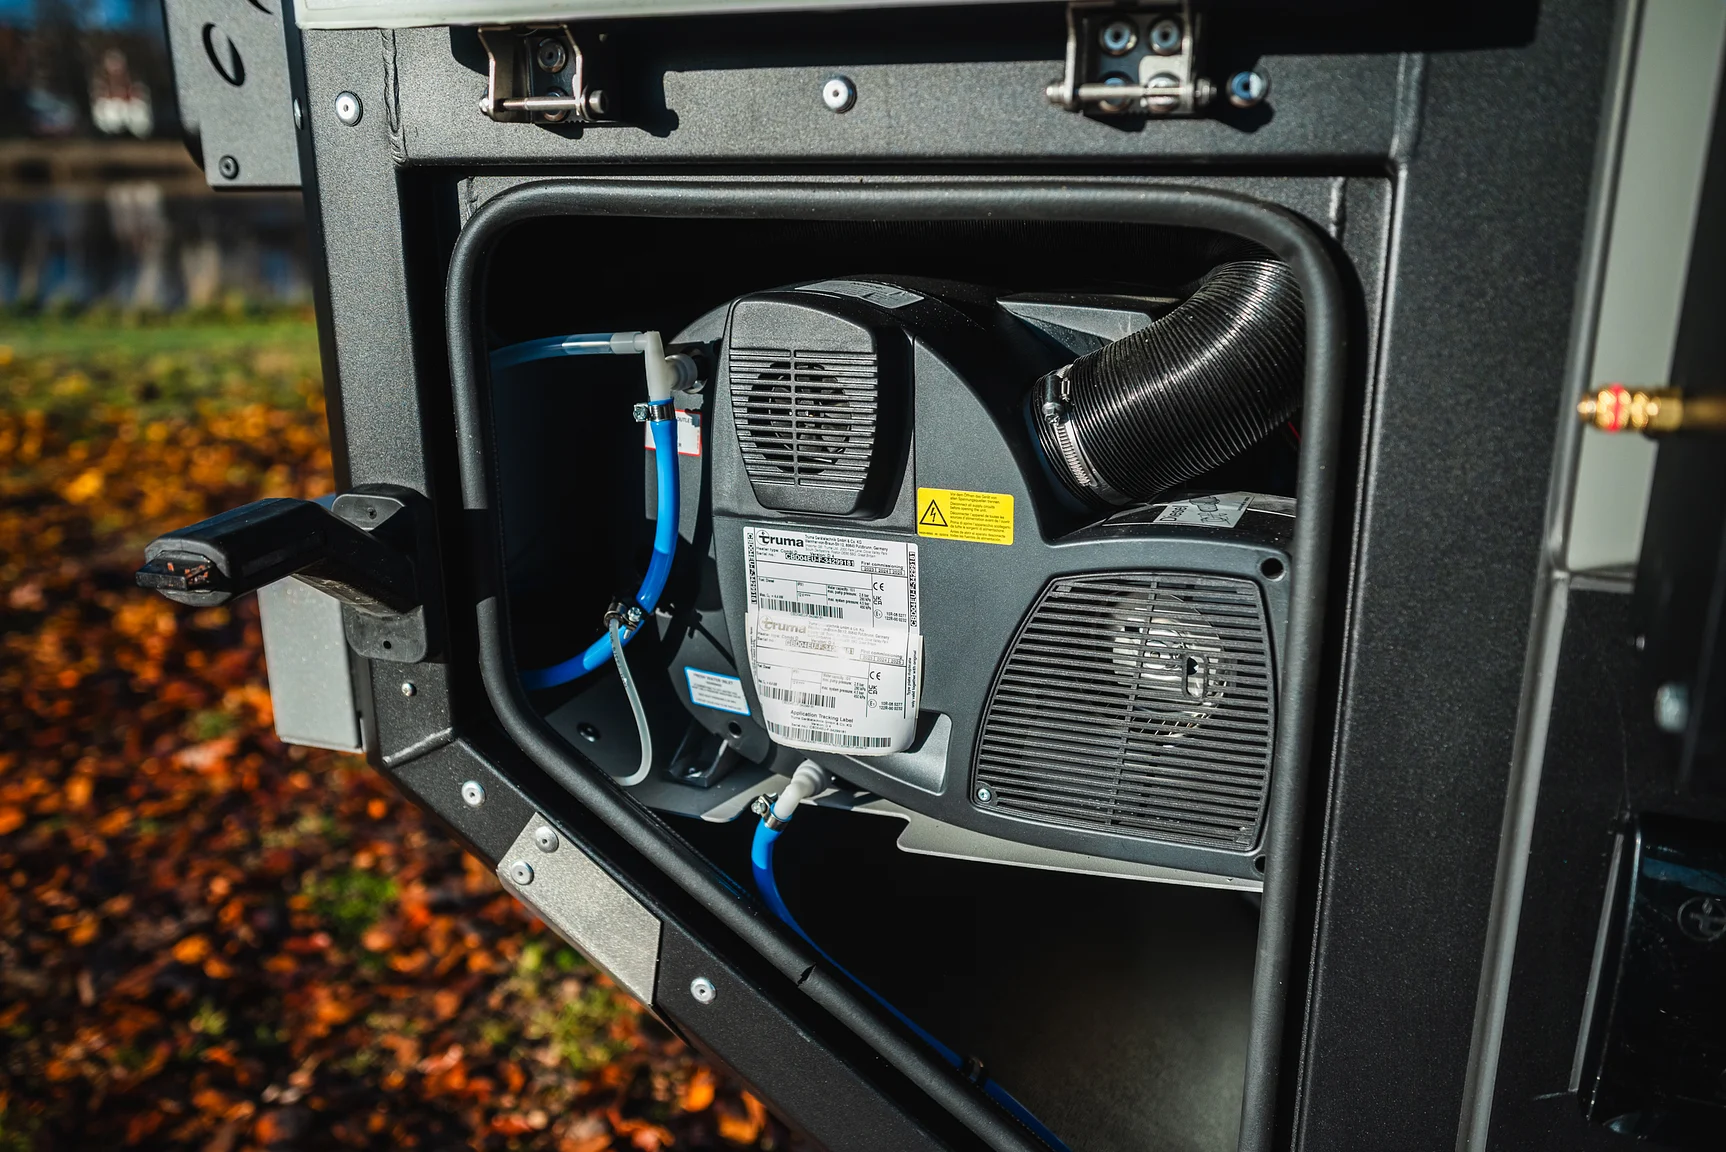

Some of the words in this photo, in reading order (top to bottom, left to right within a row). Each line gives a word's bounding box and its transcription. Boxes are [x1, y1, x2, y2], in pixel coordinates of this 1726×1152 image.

[1160, 505, 1188, 521] Diesel
[758, 532, 804, 547] truma
[872, 562, 904, 570] commissioning
[873, 582, 884, 591] CE
[762, 616, 806, 633] truma
[871, 650, 902, 660] commissioning
[870, 671, 881, 680] CE
[790, 710, 818, 718] Application
